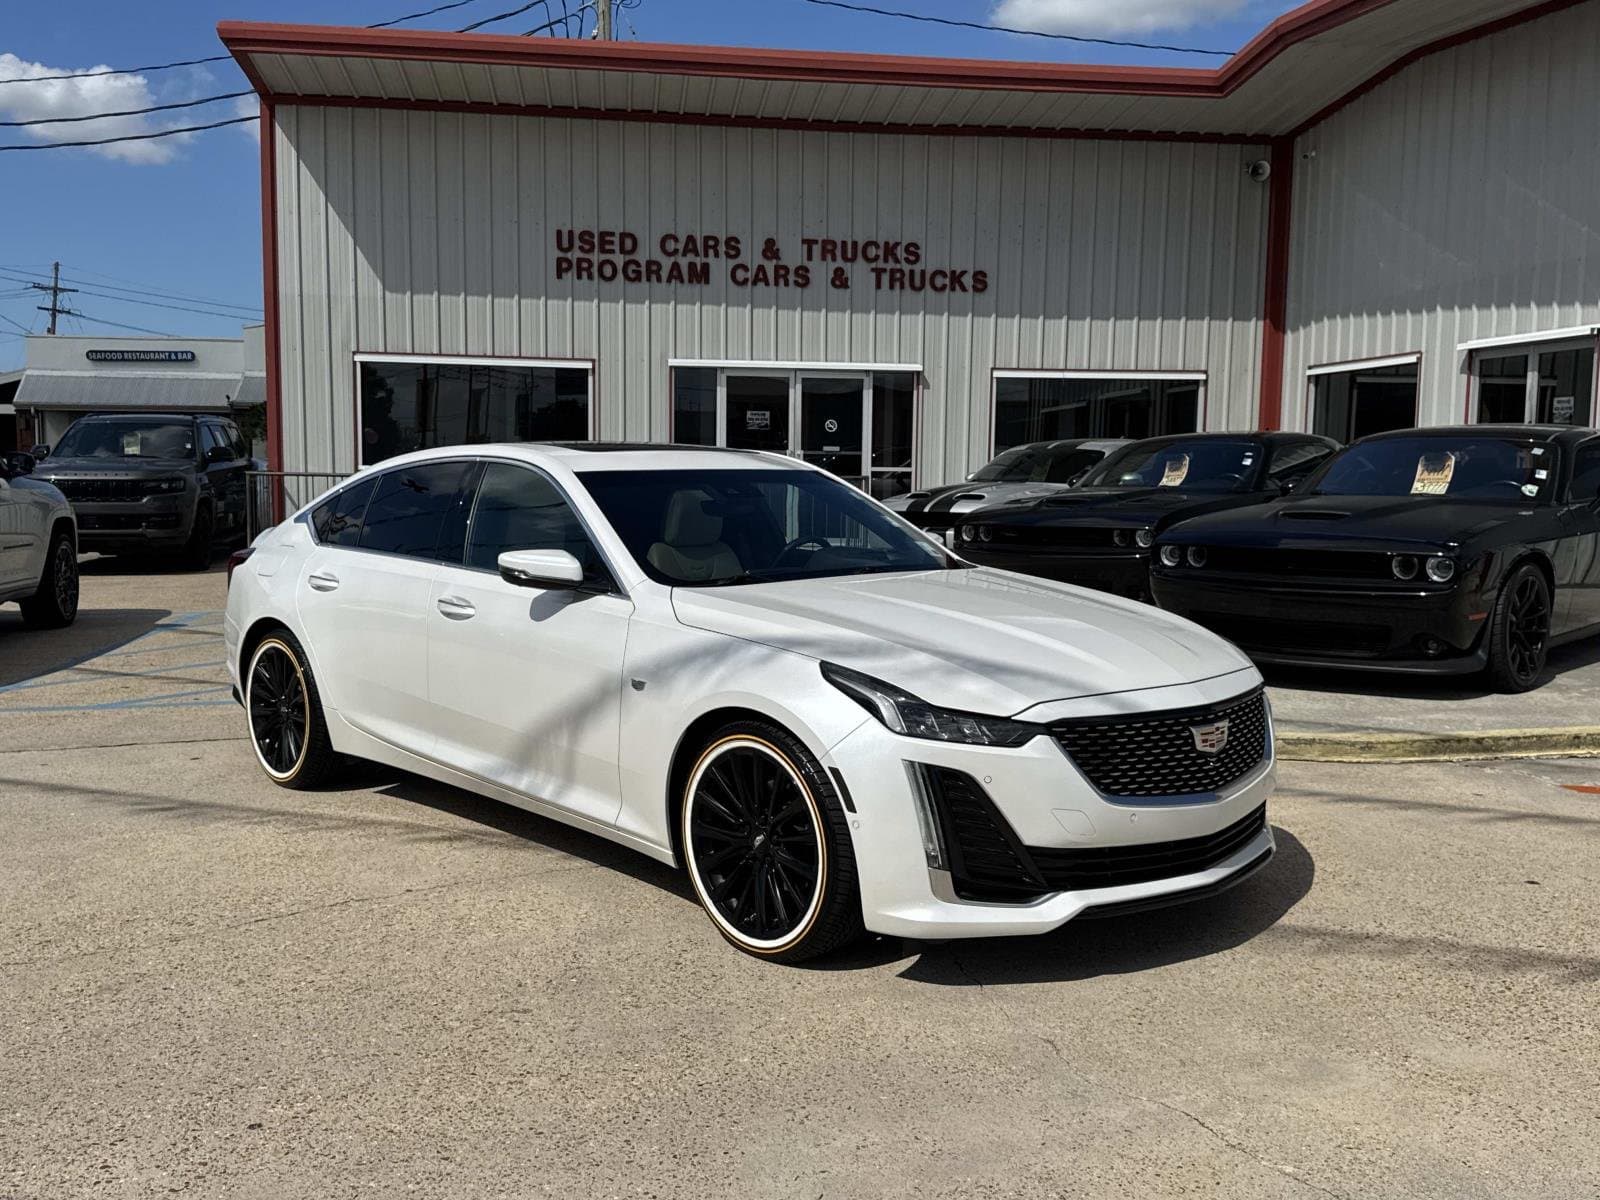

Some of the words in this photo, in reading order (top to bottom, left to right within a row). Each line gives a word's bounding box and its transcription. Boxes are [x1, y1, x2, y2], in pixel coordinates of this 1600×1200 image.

[556, 229, 638, 255] USED
[659, 233, 741, 259] CARS
[762, 238, 780, 260] &
[802, 238, 921, 264] TRUCKS
[555, 257, 711, 285] PROGRAM
[730, 263, 811, 288] CARS
[830, 266, 849, 288] &
[873, 267, 988, 293] TRUCKS
[88, 352, 122, 360] SEAFOOD
[124, 352, 169, 360] RESTAURANT
[171, 352, 176, 360] &
[177, 352, 192, 360] BAR
